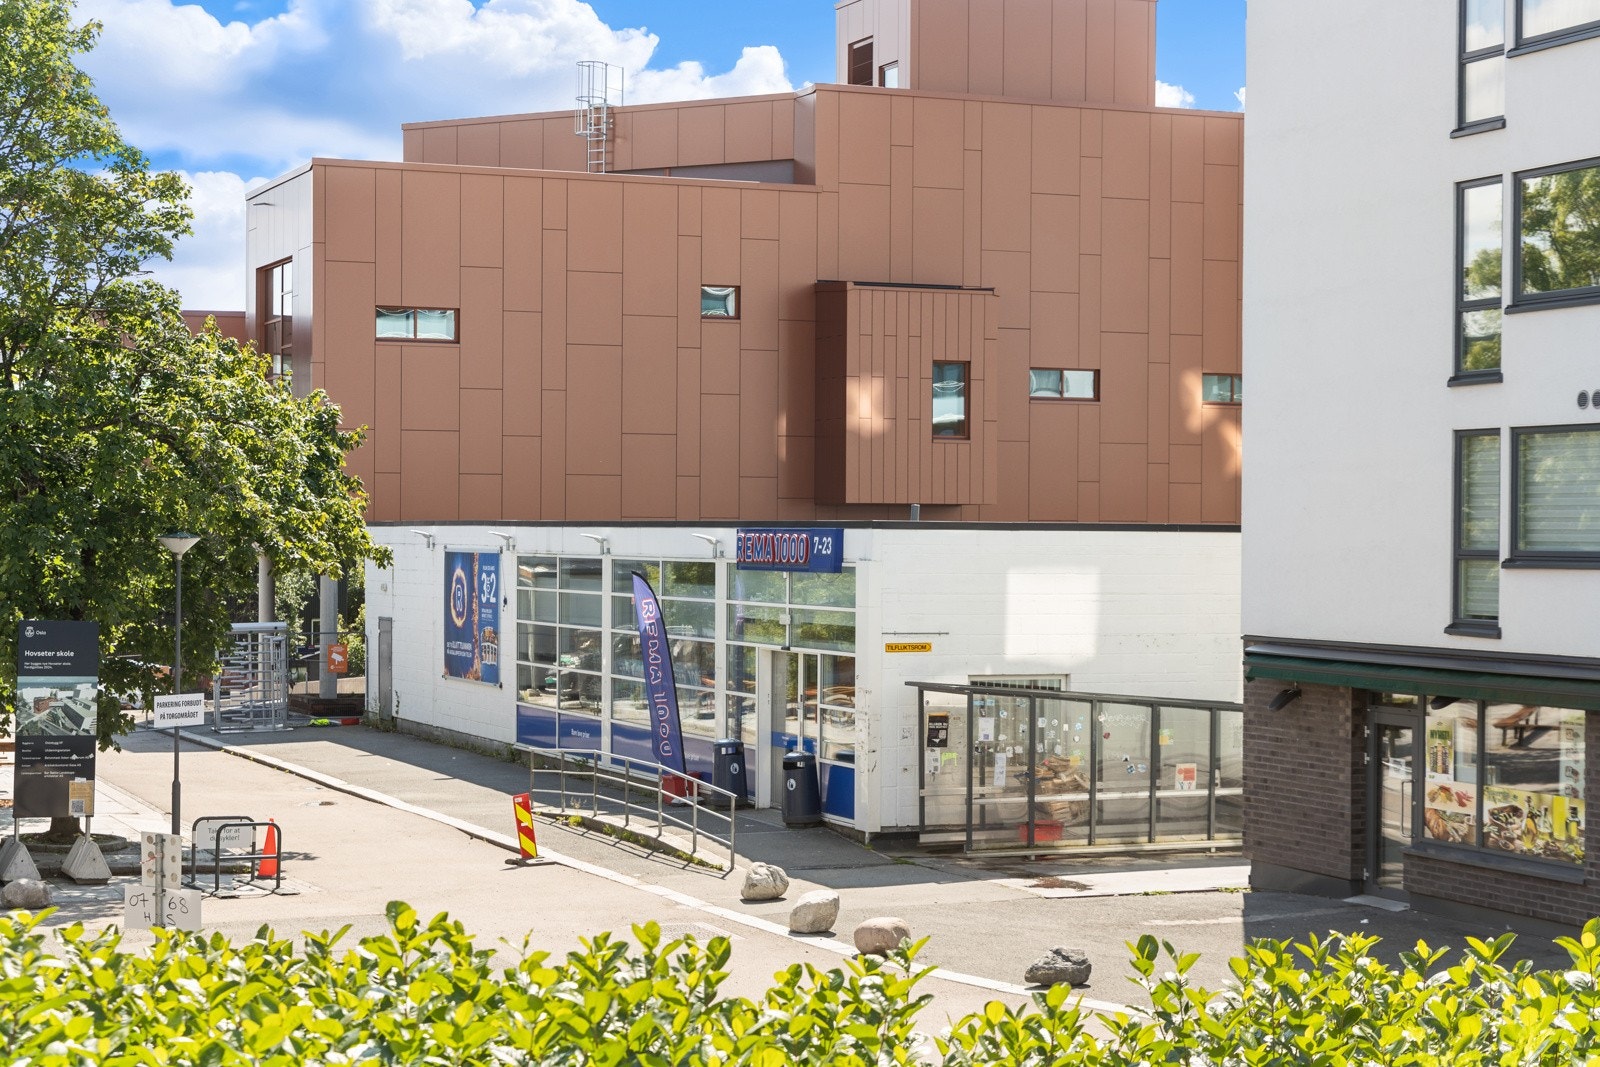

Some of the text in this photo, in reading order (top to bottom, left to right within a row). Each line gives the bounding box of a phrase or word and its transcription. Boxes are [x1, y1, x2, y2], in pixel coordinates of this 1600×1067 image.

[737, 533, 810, 565] REMA 1000
[813, 536, 832, 554] 7-23
[642, 599, 662, 685] REMA
[181, 699, 202, 707] FORBUDT
[166, 711, 199, 720] TORGOMRÅDET
